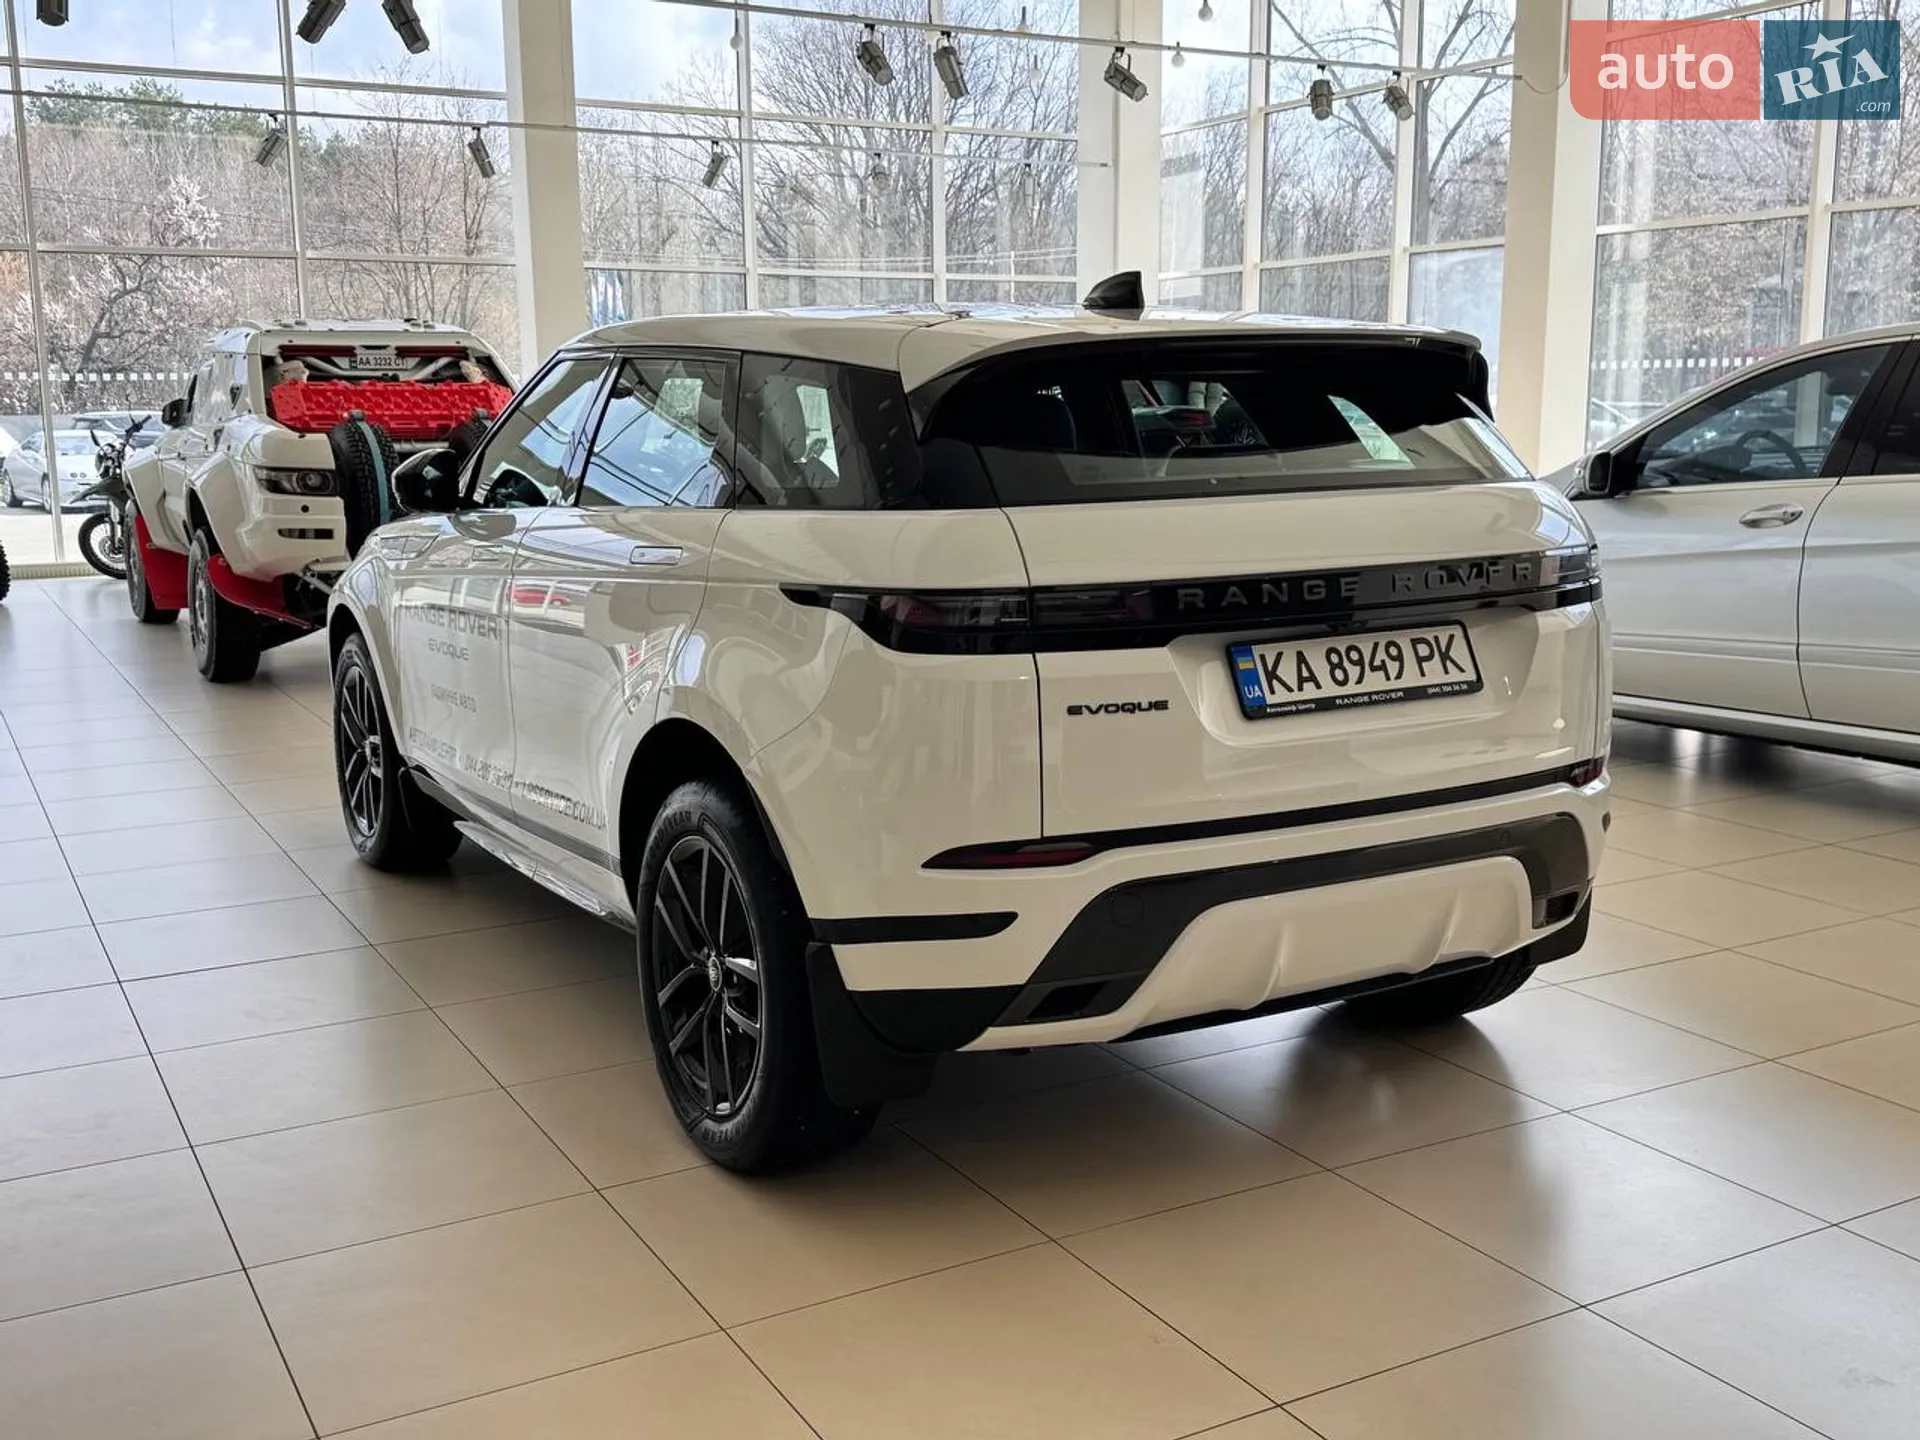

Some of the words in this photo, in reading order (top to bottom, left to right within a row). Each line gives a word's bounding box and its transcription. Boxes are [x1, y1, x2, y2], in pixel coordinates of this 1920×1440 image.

[1177, 577, 1360, 610] RANGE
[1391, 560, 1533, 596] ROVER
[448, 609, 499, 641] ROVER
[428, 638, 469, 661] EVOQUE
[1259, 650, 1322, 696] KA
[1325, 639, 1405, 688] 8949
[1409, 633, 1467, 678] PK
[1244, 685, 1263, 698] UA
[1335, 696, 1371, 706] RANGE
[1371, 691, 1405, 701] ROVER
[1067, 700, 1169, 716] EVOQUE
